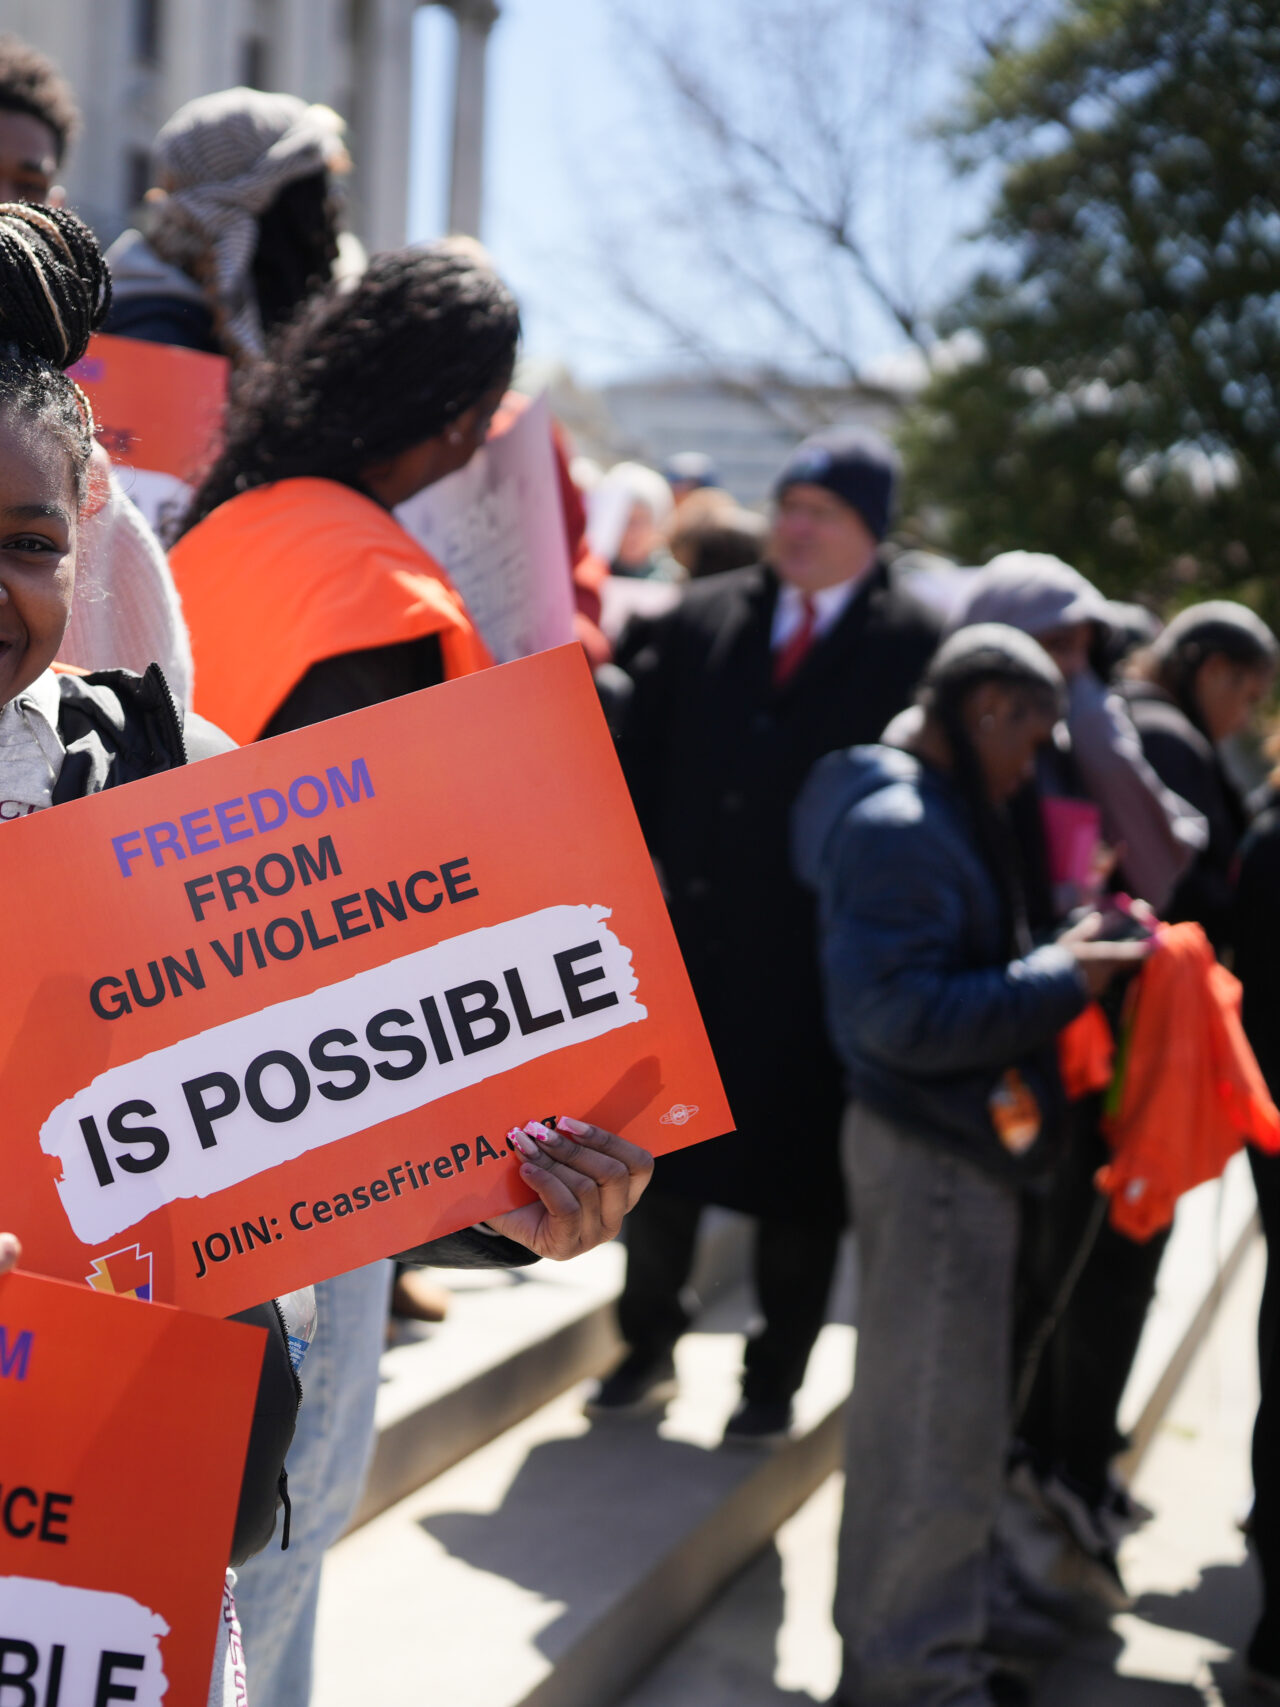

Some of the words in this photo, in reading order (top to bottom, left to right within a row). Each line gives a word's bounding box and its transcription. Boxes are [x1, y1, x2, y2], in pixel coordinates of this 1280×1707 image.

[110, 757, 376, 878] FREEDOM
[183, 834, 343, 922] FROM
[89, 948, 206, 1021] GUN
[209, 856, 480, 979] VIOLENCE
[78, 1099, 170, 1188] IS
[181, 939, 620, 1150] POSSIBLE
[191, 1216, 284, 1279] JOIN:
